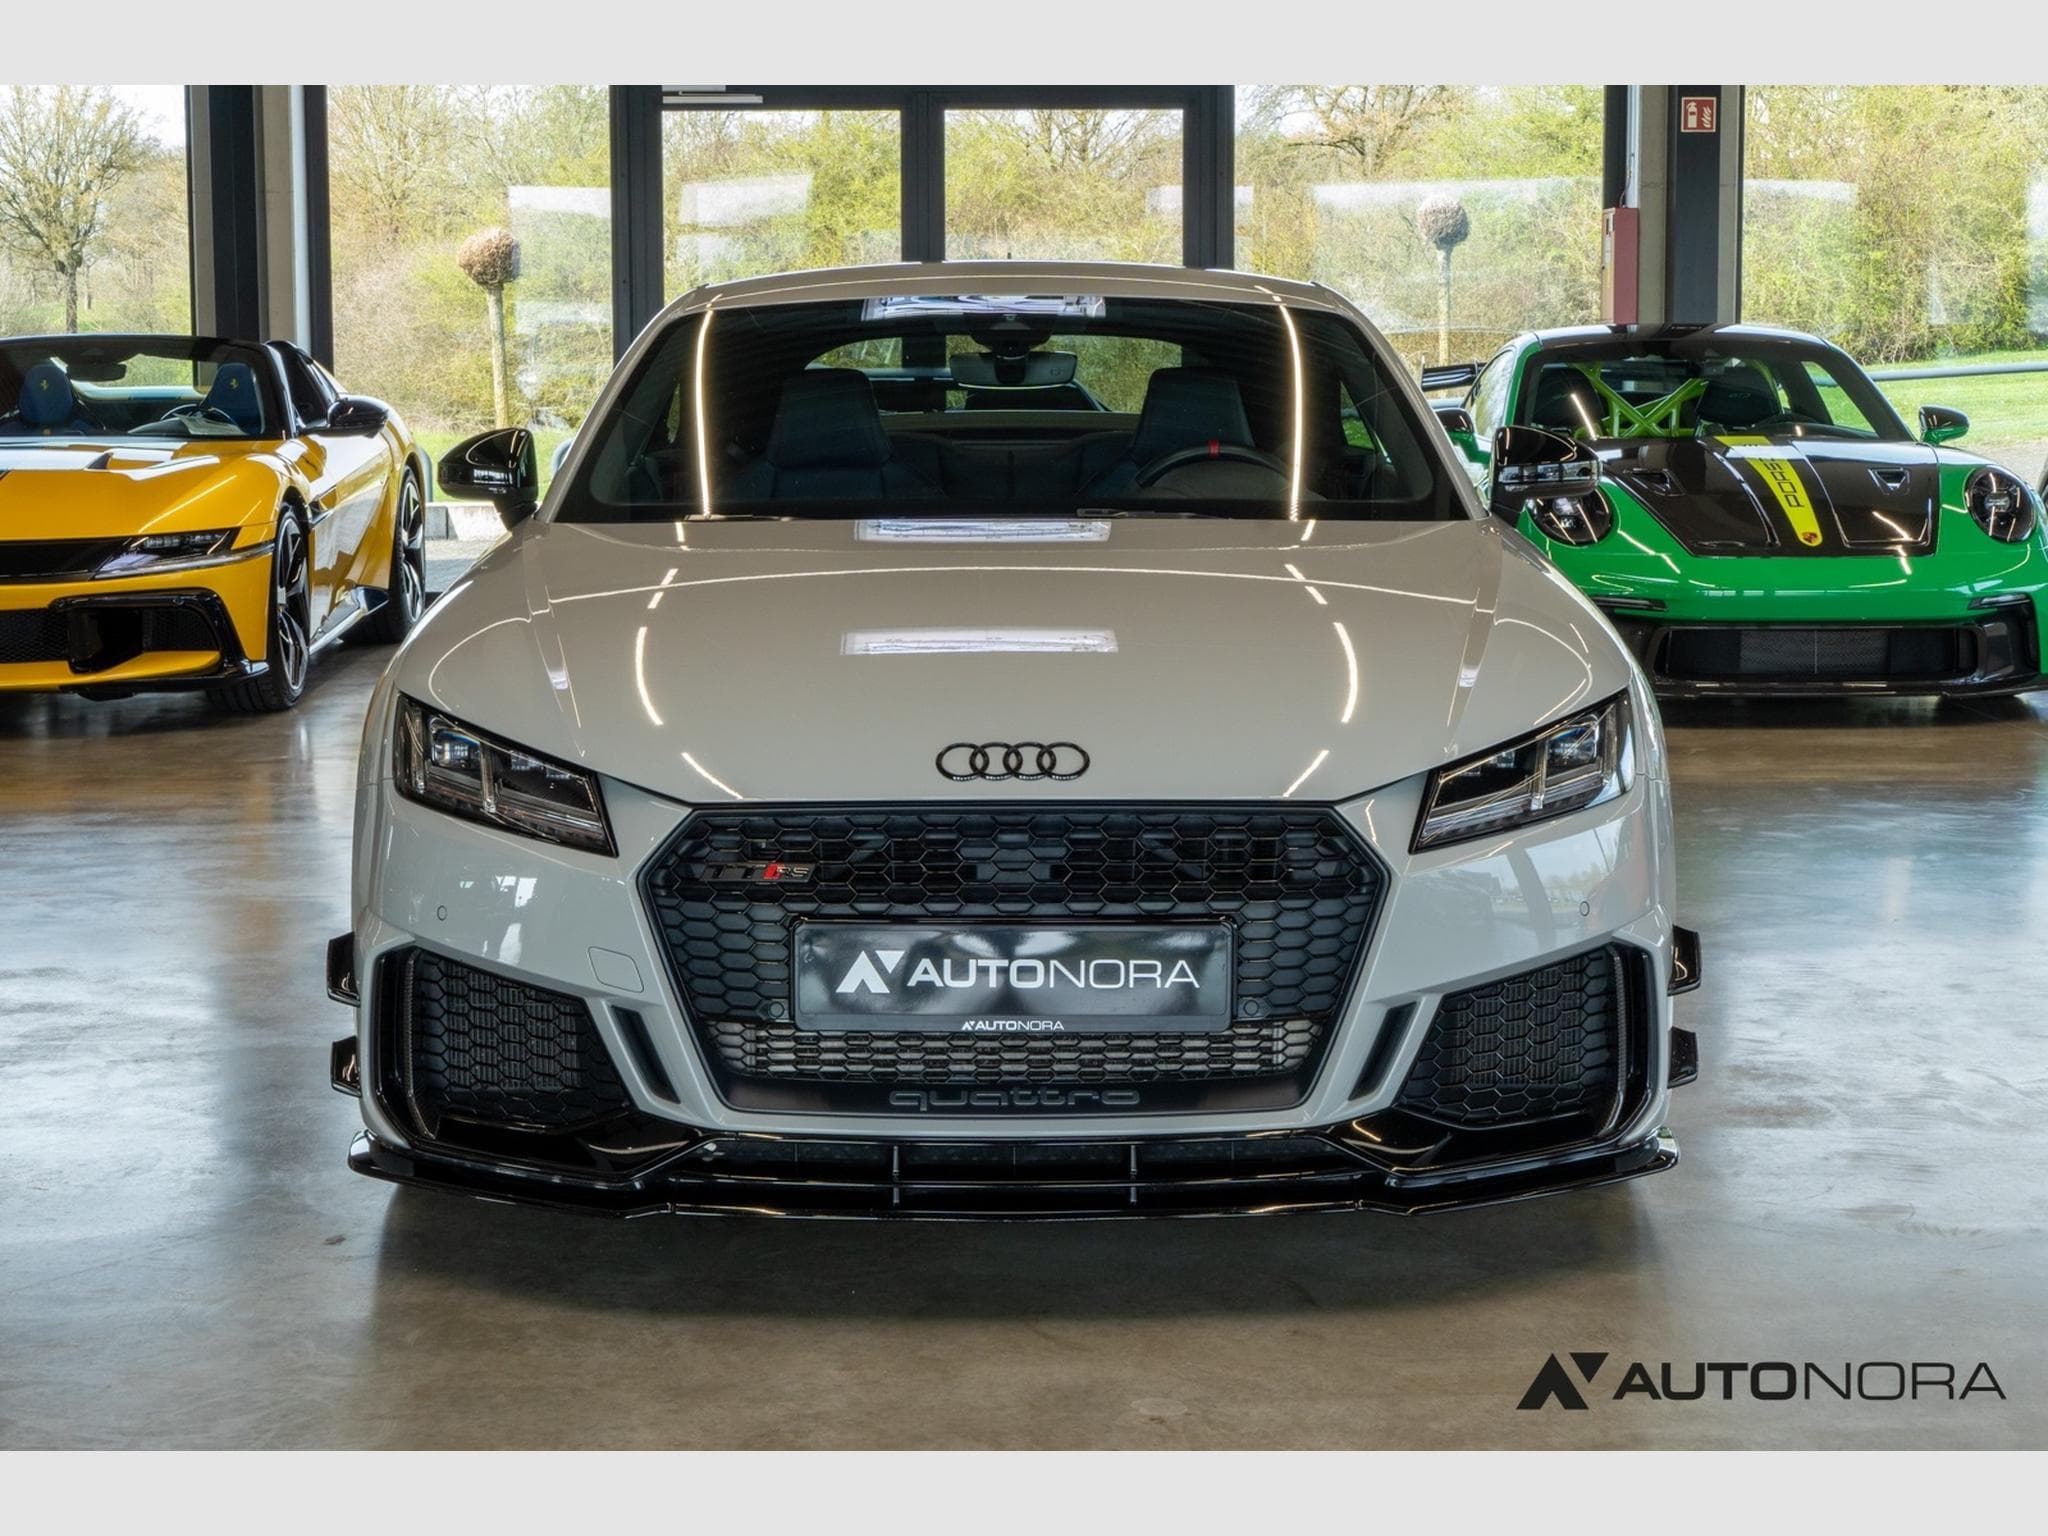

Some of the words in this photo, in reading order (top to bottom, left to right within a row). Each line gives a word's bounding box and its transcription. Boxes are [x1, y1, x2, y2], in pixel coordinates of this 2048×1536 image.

[907, 958, 1200, 988] AUTONORA
[975, 1020, 1064, 1031] AUTONORA
[889, 1087, 1140, 1111] quattro
